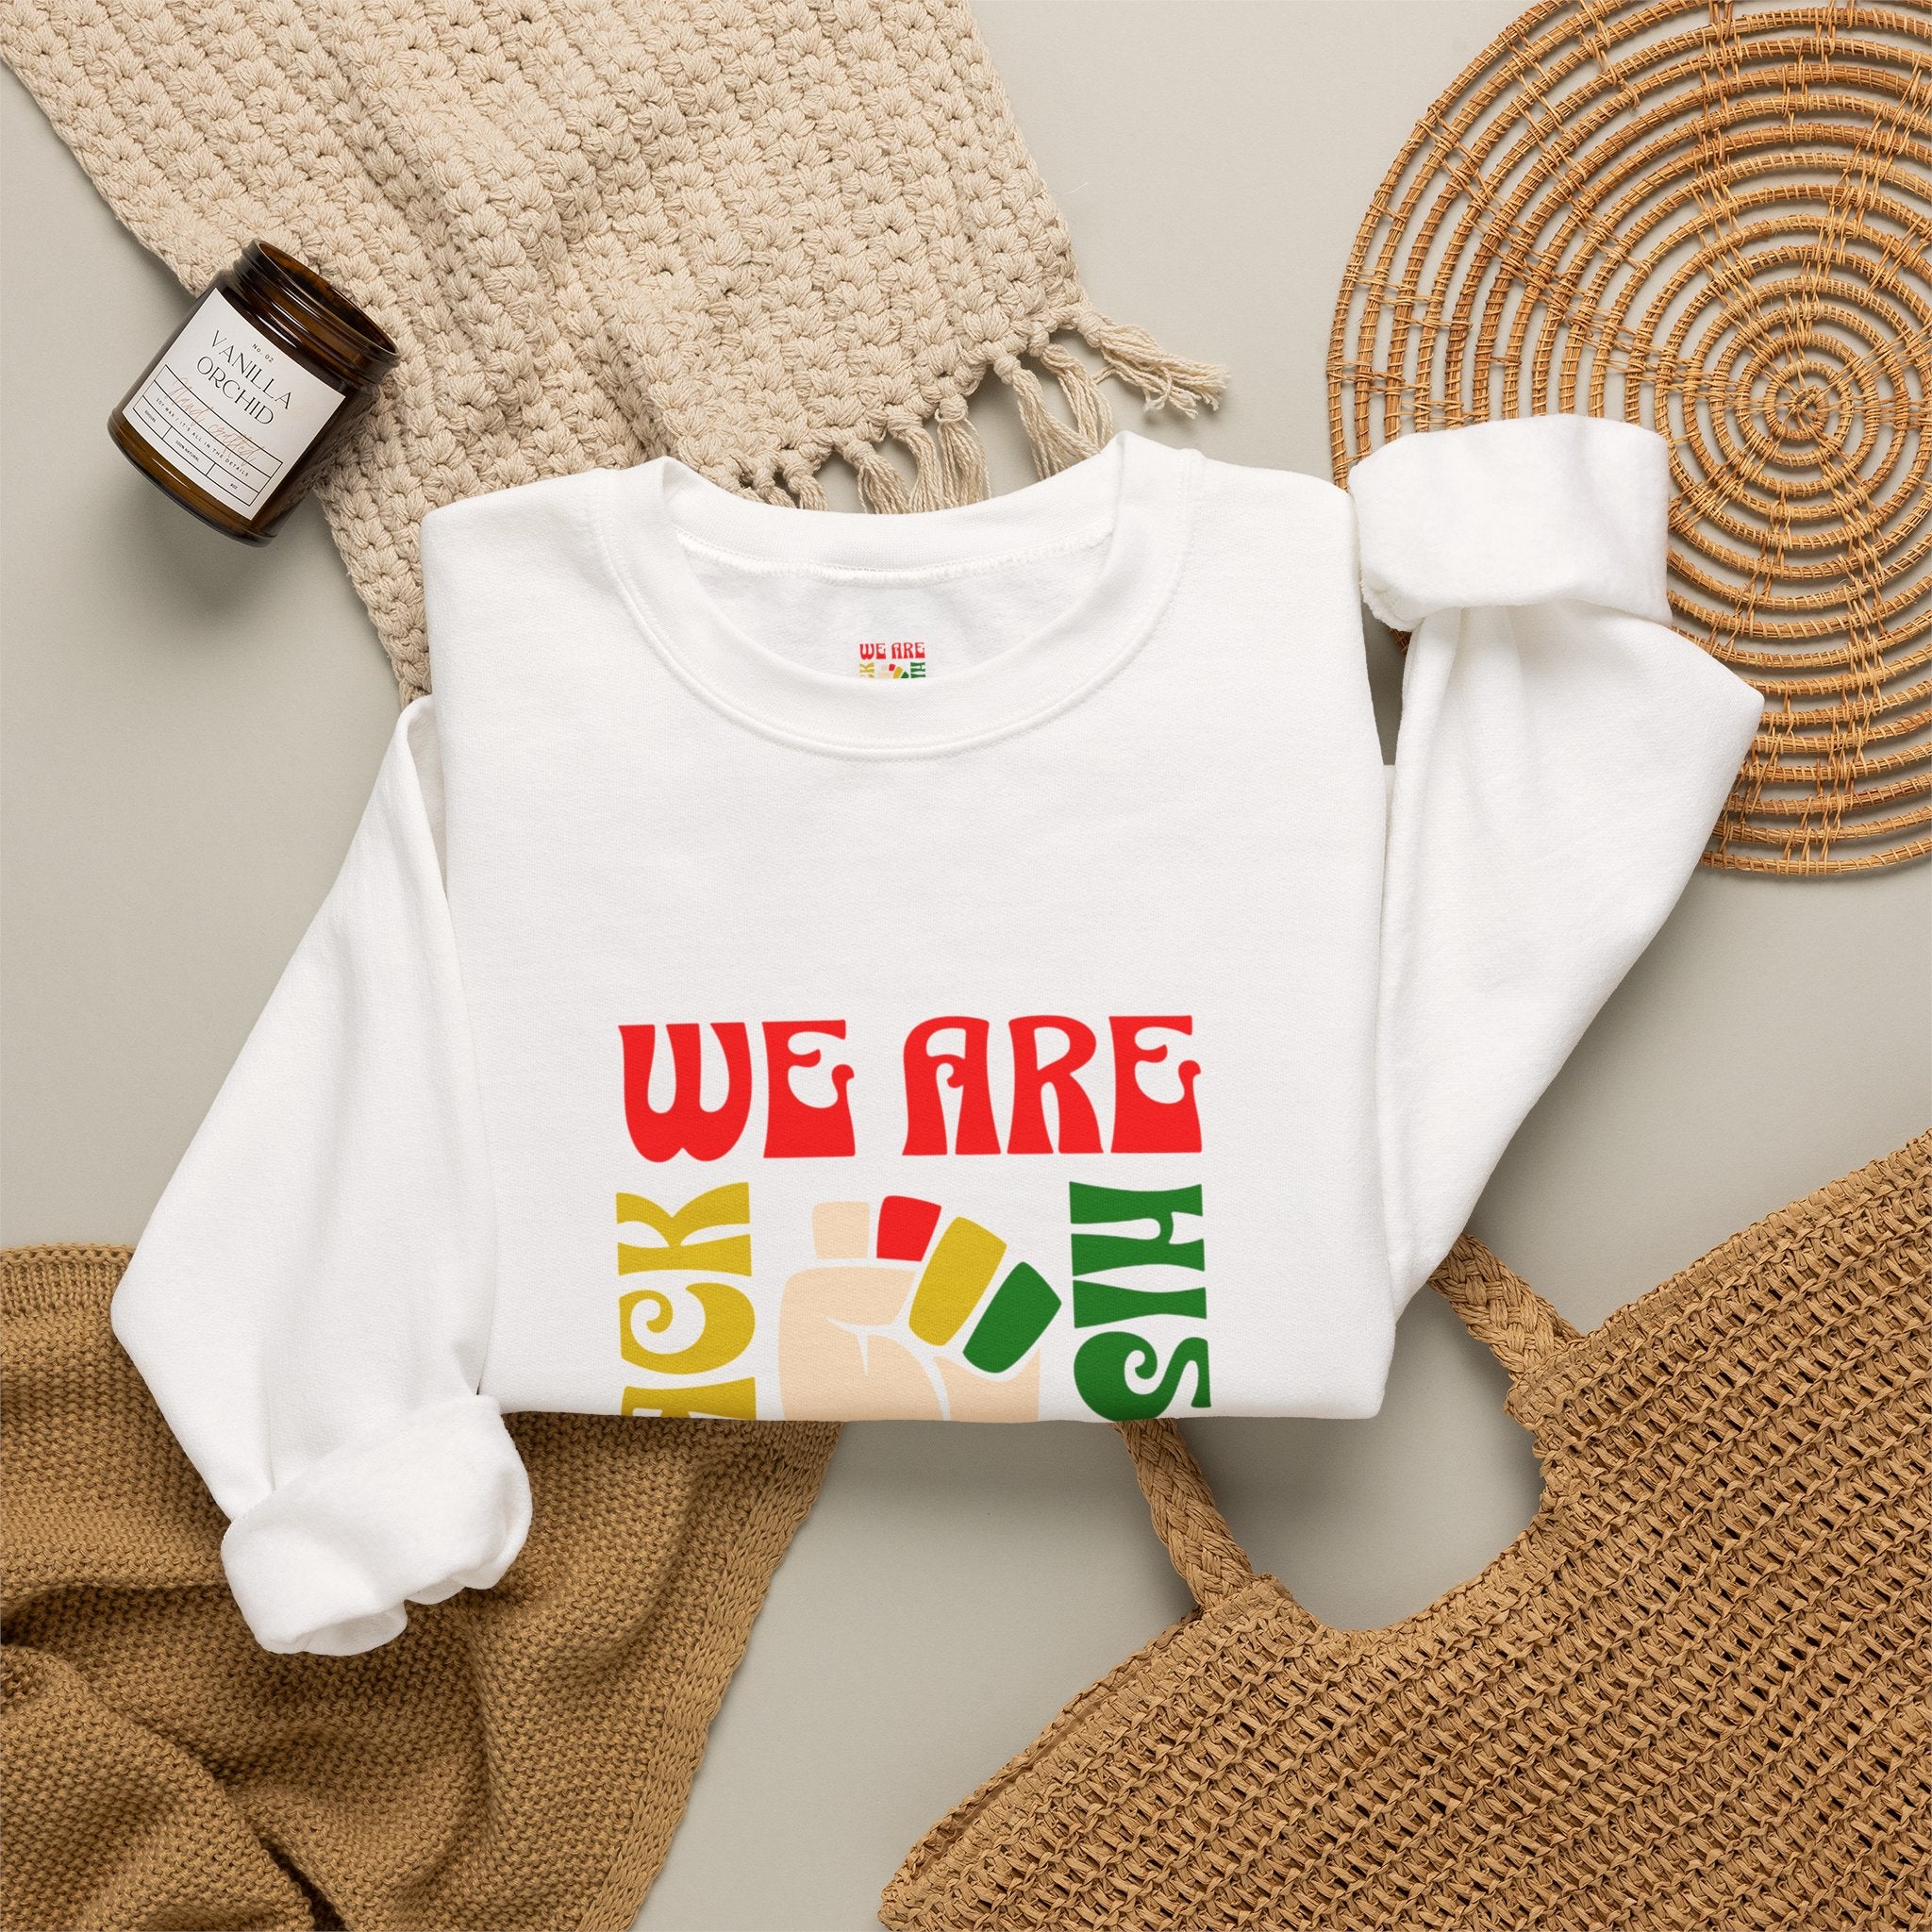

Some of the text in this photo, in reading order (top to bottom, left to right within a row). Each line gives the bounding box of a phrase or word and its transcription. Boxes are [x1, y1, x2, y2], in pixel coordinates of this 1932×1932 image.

[211, 329, 291, 409] VANILLA
[252, 343, 275, 363] No. 02
[197, 356, 275, 425] ORCHID
[156, 397, 165, 407] SOY
[165, 408, 175, 417] WAX
[192, 432, 201, 442] ALL
[204, 441, 211, 449] IN
[212, 448, 224, 458] THE
[225, 458, 249, 477] DETAILS
[859, 641, 925, 660] WE ARE
[618, 1015, 1202, 1162] WE ARE
